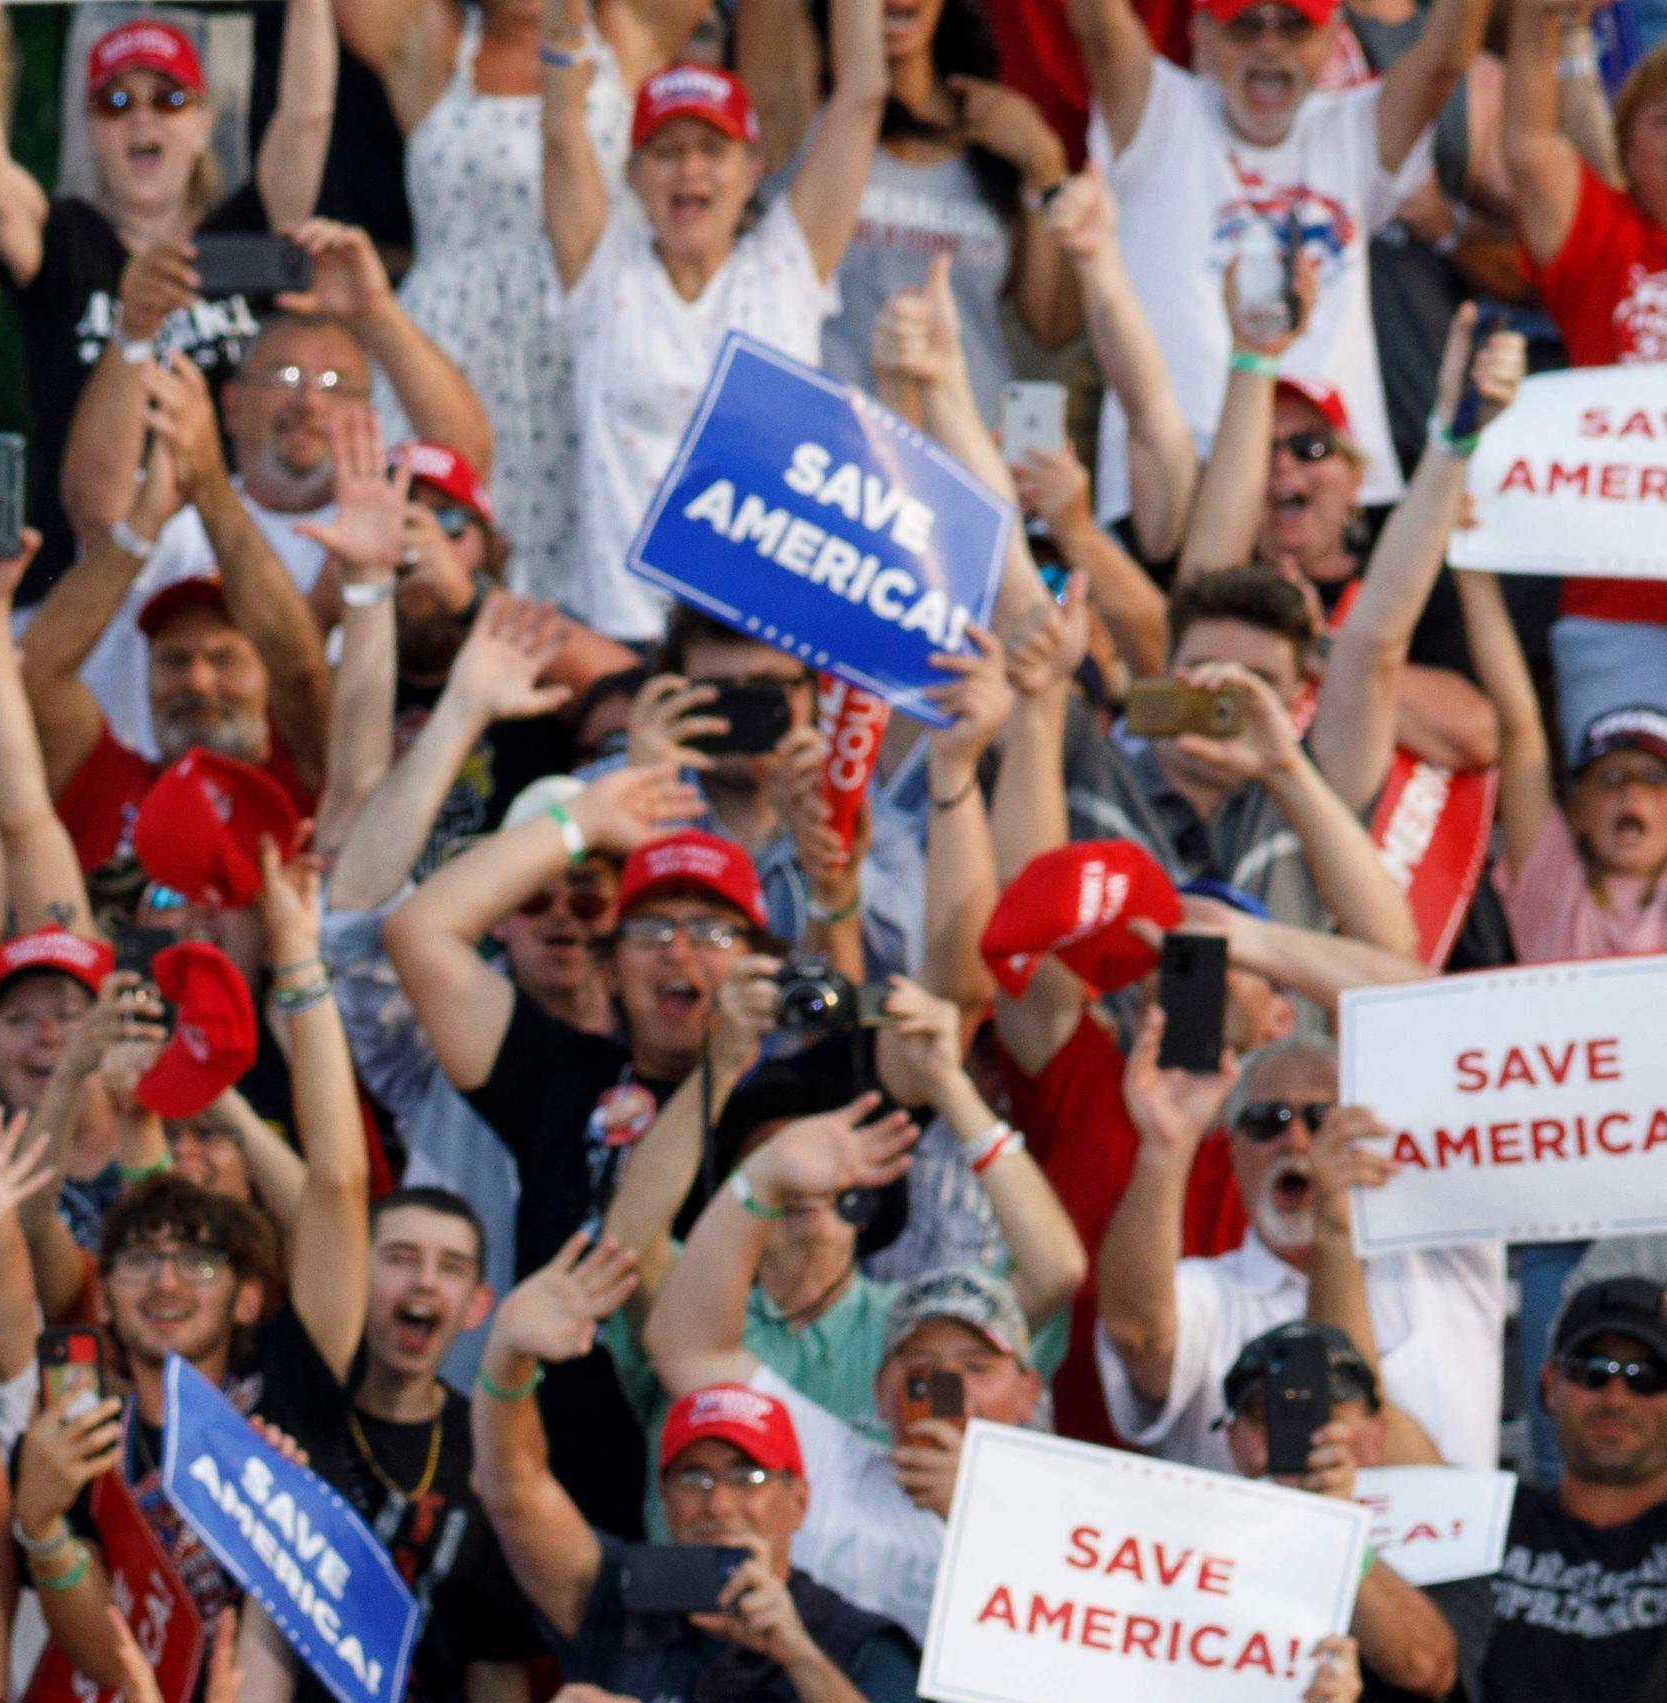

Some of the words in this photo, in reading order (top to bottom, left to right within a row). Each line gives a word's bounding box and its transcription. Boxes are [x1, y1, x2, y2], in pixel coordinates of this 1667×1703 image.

[1578, 408, 1667, 440] SA
[784, 443, 935, 557] SAVE
[684, 478, 971, 653] AMERICA!
[1454, 1037, 1622, 1093] SAVE
[190, 1456, 382, 1698] AMERICA!
[240, 1456, 350, 1599] SAVE
[1065, 1526, 1236, 1595] SAVE
[975, 1585, 1300, 1680] AMERICA!
